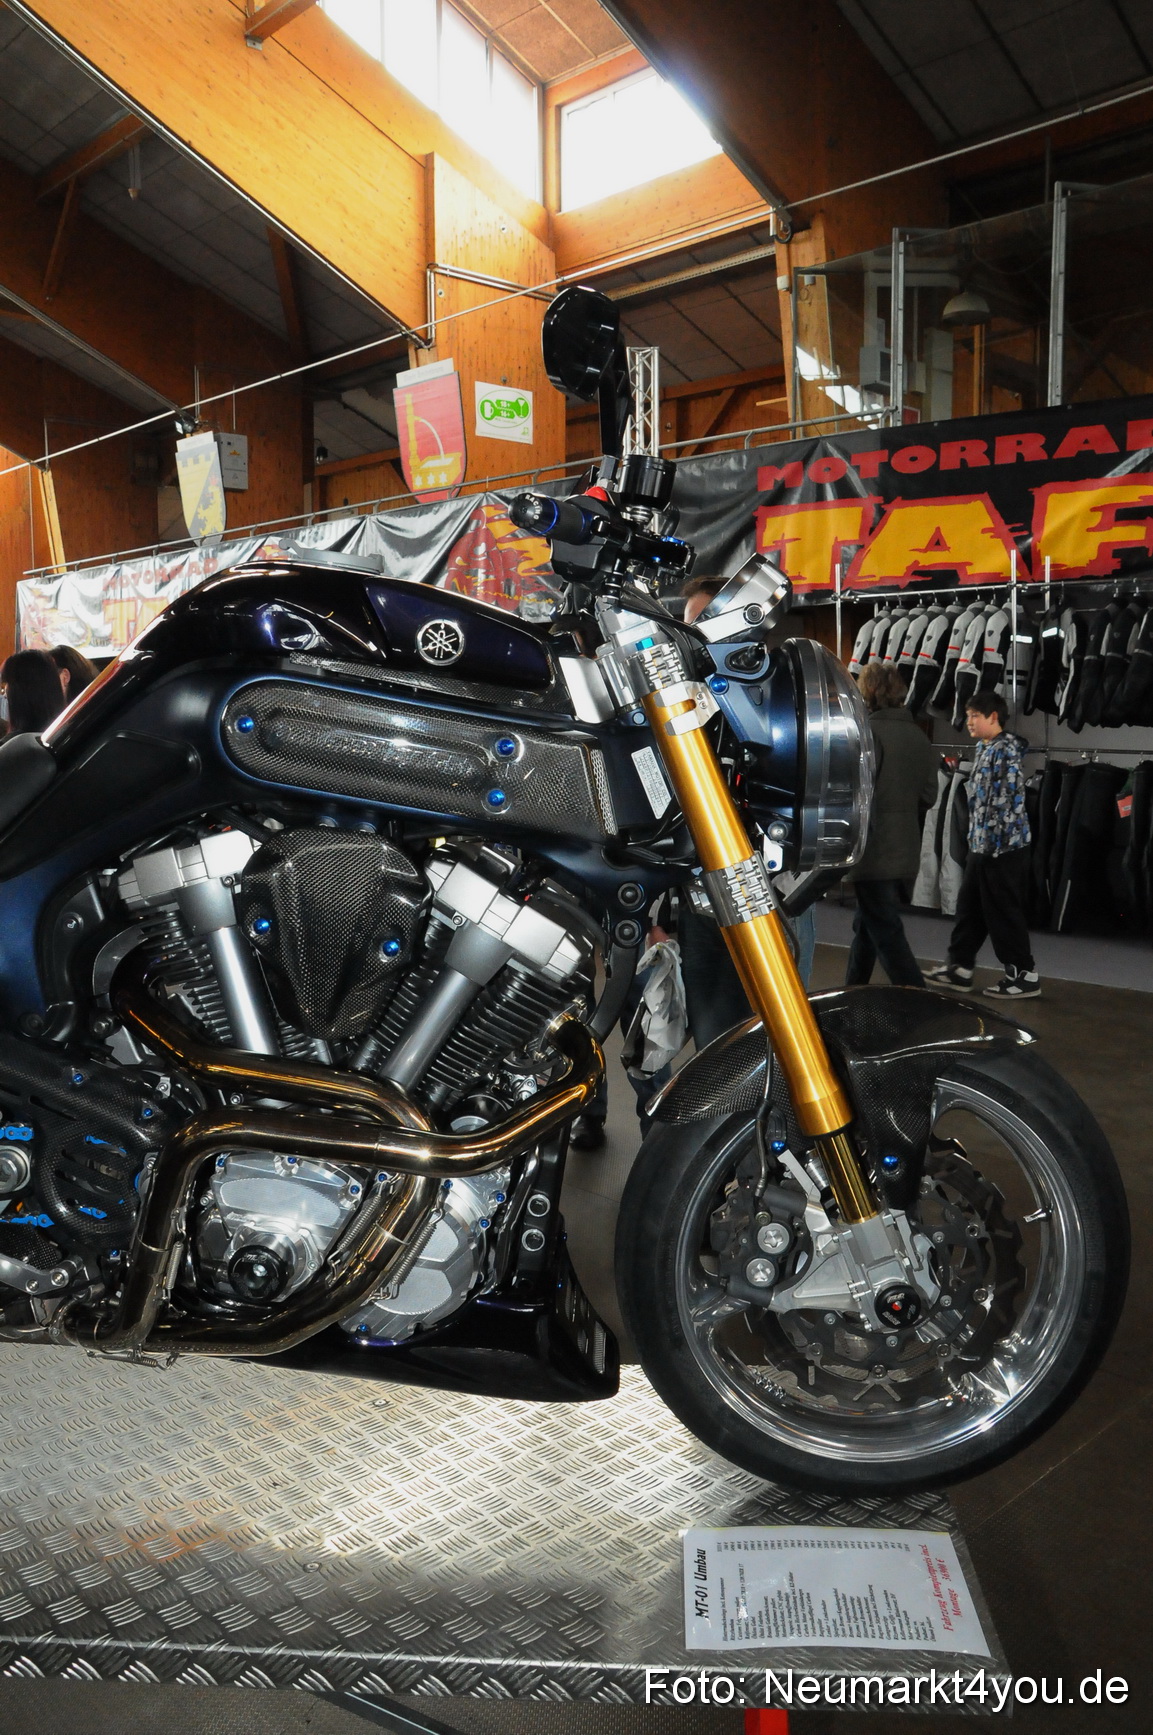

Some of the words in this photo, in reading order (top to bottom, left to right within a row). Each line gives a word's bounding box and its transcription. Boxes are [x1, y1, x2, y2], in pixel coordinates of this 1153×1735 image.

[103, 557, 219, 591] MOTORRAD
[694, 1548, 707, 1581] Umbau
[694, 1586, 709, 1619] MT-01
[938, 1600, 954, 1631] Fahrzeug
[948, 1588, 963, 1617] Montage
